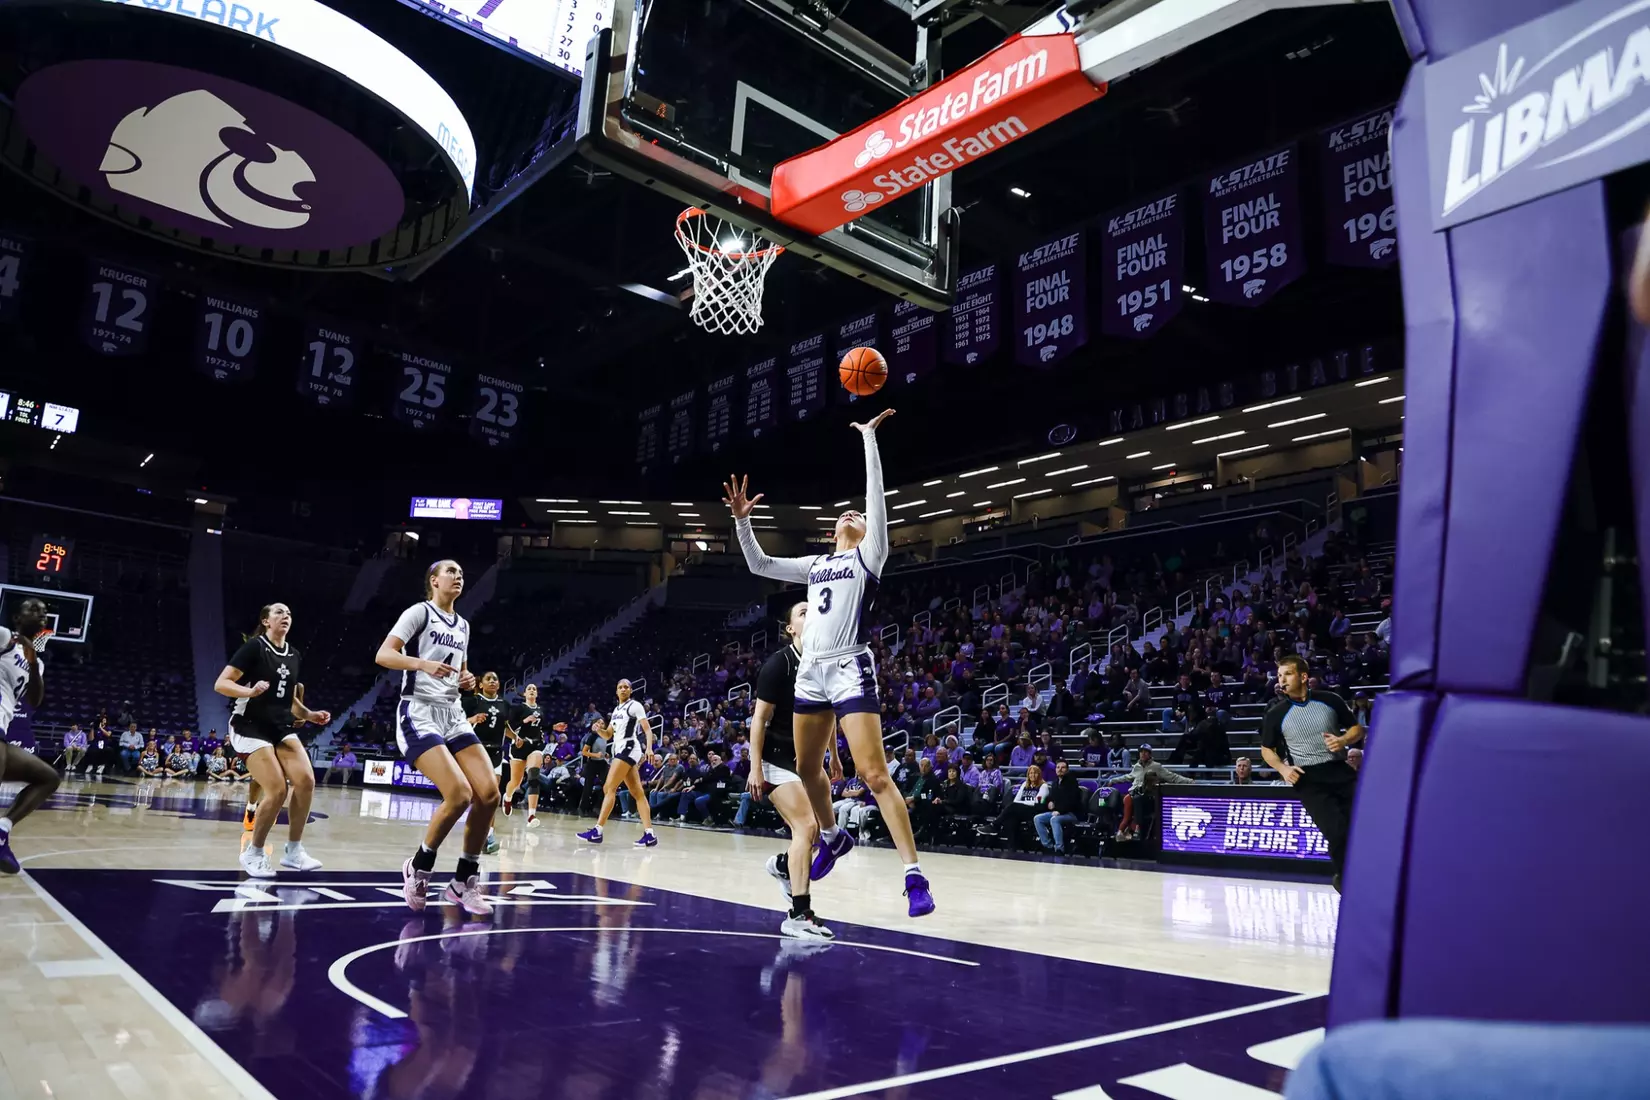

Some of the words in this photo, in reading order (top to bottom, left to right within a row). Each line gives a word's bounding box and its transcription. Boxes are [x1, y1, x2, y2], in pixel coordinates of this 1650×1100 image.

[566, 24, 573, 33] 7
[568, 12, 575, 22] 5
[559, 35, 573, 47] 27
[557, 48, 571, 61] 30
[1328, 109, 1394, 149] K-STA
[1209, 149, 1290, 194] K-STATE
[1343, 151, 1392, 184] FINA
[1215, 184, 1237, 197] MEN'S
[1238, 167, 1285, 190] BASKETBALL
[1344, 169, 1393, 203] FOU
[1108, 194, 1177, 233] K-STATE
[1221, 192, 1281, 227] FINAL
[1112, 225, 1132, 237] MEN'S
[1132, 210, 1172, 231] BASKETBALL
[1222, 210, 1280, 244] FOUR
[1343, 204, 1397, 243] 196
[0, 238, 24, 253] ELL
[1017, 232, 1080, 268] K-STATE
[1117, 233, 1168, 265] FINAL
[1021, 260, 1039, 272] MEN'S
[1039, 247, 1075, 266] BASKETBALL
[1117, 249, 1167, 281] FOUR
[1220, 242, 1288, 282] 1958
[99, 266, 148, 288] KRUGER
[1026, 269, 1071, 298] FINAL
[92, 282, 147, 332] 12
[206, 296, 259, 319] WILLIAMS
[952, 302, 971, 315] ELITE
[971, 292, 993, 308] EIGHT
[1026, 285, 1070, 314] FOUR
[1117, 279, 1171, 316] 1951
[839, 313, 876, 336] K-STATE
[891, 324, 911, 338] SWEET
[911, 315, 934, 331] SIXTEEN
[975, 315, 990, 326] 1972
[975, 324, 990, 335] 1973
[1023, 314, 1074, 347] 1948
[92, 327, 132, 344] 1971-74
[204, 312, 254, 357] 10
[318, 328, 351, 345] EVANS
[790, 333, 824, 354] K-STATE
[955, 339, 969, 349] 1961
[975, 332, 991, 343] 1975
[309, 341, 355, 386] 12
[402, 352, 451, 374] BLACKMAN
[1261, 345, 1374, 398] STATE
[399, 366, 446, 408] 25
[478, 373, 524, 393] RICHMOND
[751, 377, 768, 390] NCAA
[17, 398, 35, 408] 8:46
[476, 387, 519, 427] 23
[55, 413, 65, 425] 7
[36, 552, 61, 572] 27
[43, 543, 66, 556] 8:46
[809, 566, 855, 586] Wildcats
[818, 587, 833, 615] 3
[430, 630, 464, 652] Wildcat
[14, 675, 28, 700] 2
[276, 680, 287, 699] 5
[488, 715, 498, 729] 3
[1226, 801, 1278, 827] HAVE
[1279, 803, 1293, 828] A
[1223, 827, 1300, 852] BEFORE
